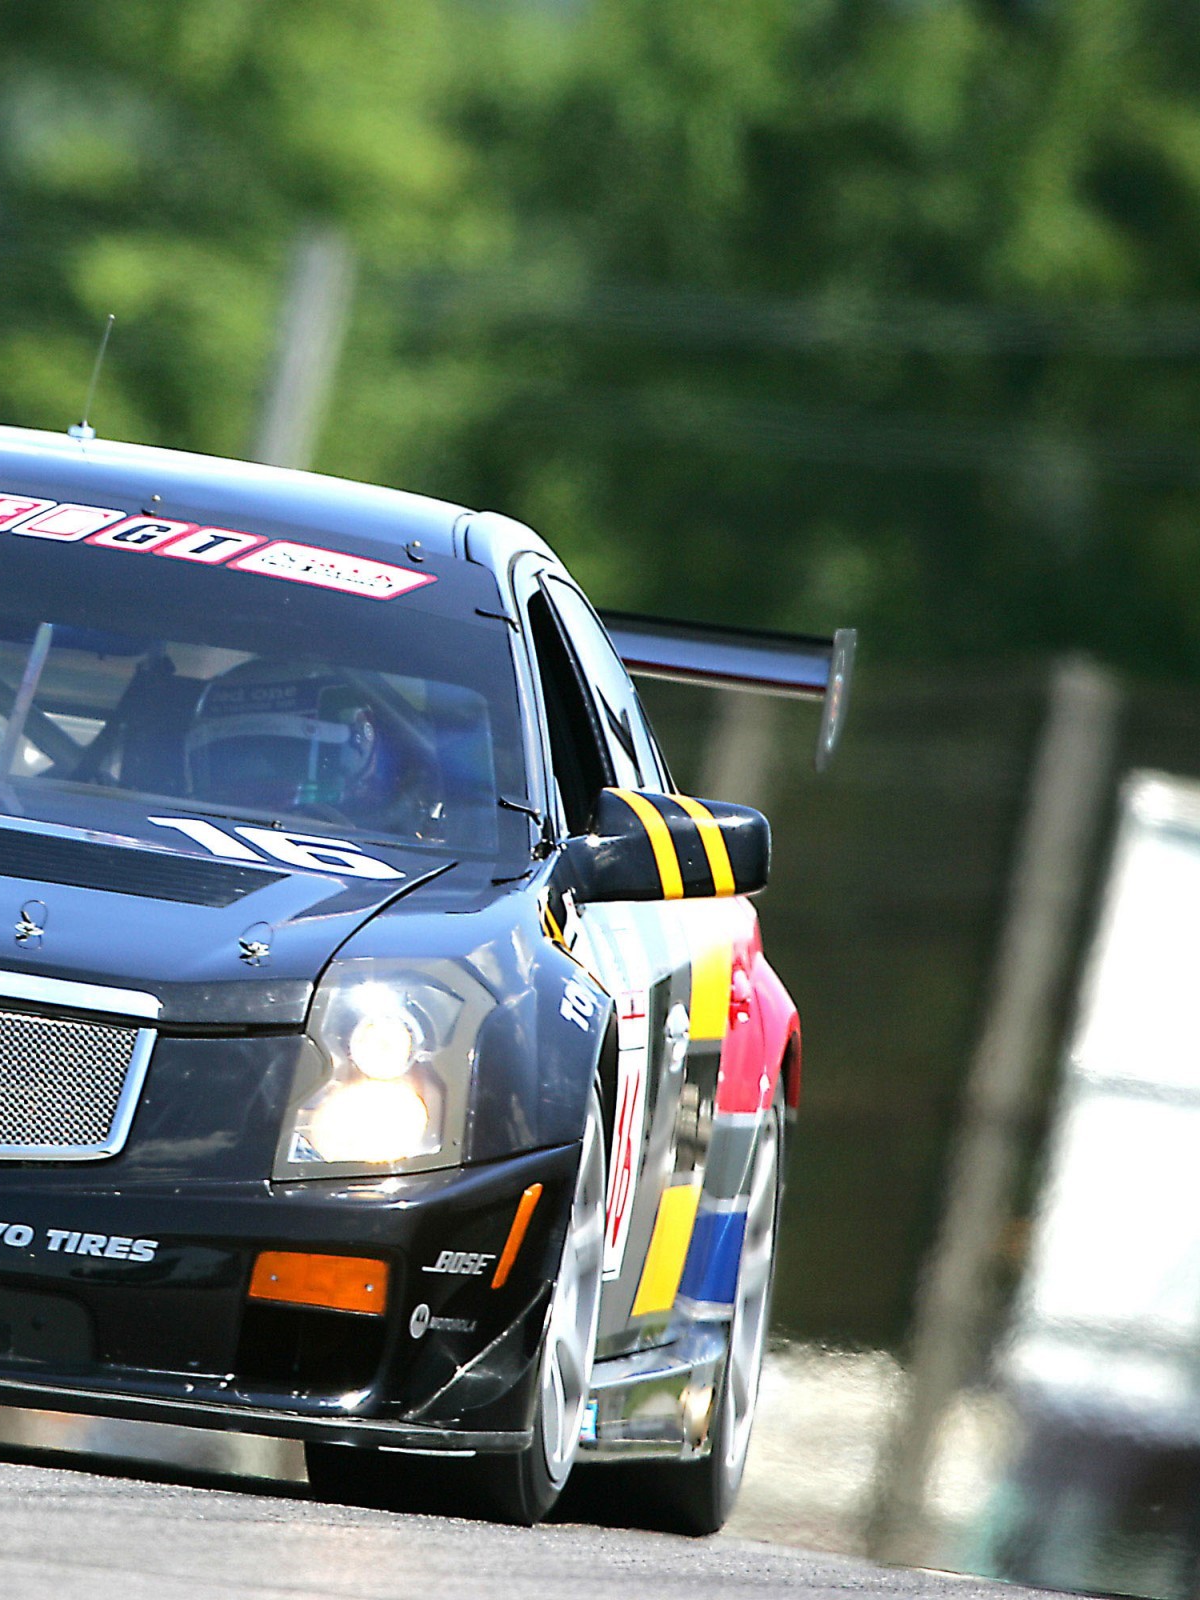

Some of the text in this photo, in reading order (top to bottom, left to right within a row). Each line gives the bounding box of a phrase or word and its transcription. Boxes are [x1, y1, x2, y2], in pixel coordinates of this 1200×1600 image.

[106, 519, 252, 558] GT
[147, 815, 407, 880] 16
[45, 1228, 159, 1264] TIRES
[421, 1250, 497, 1275] BOSE
